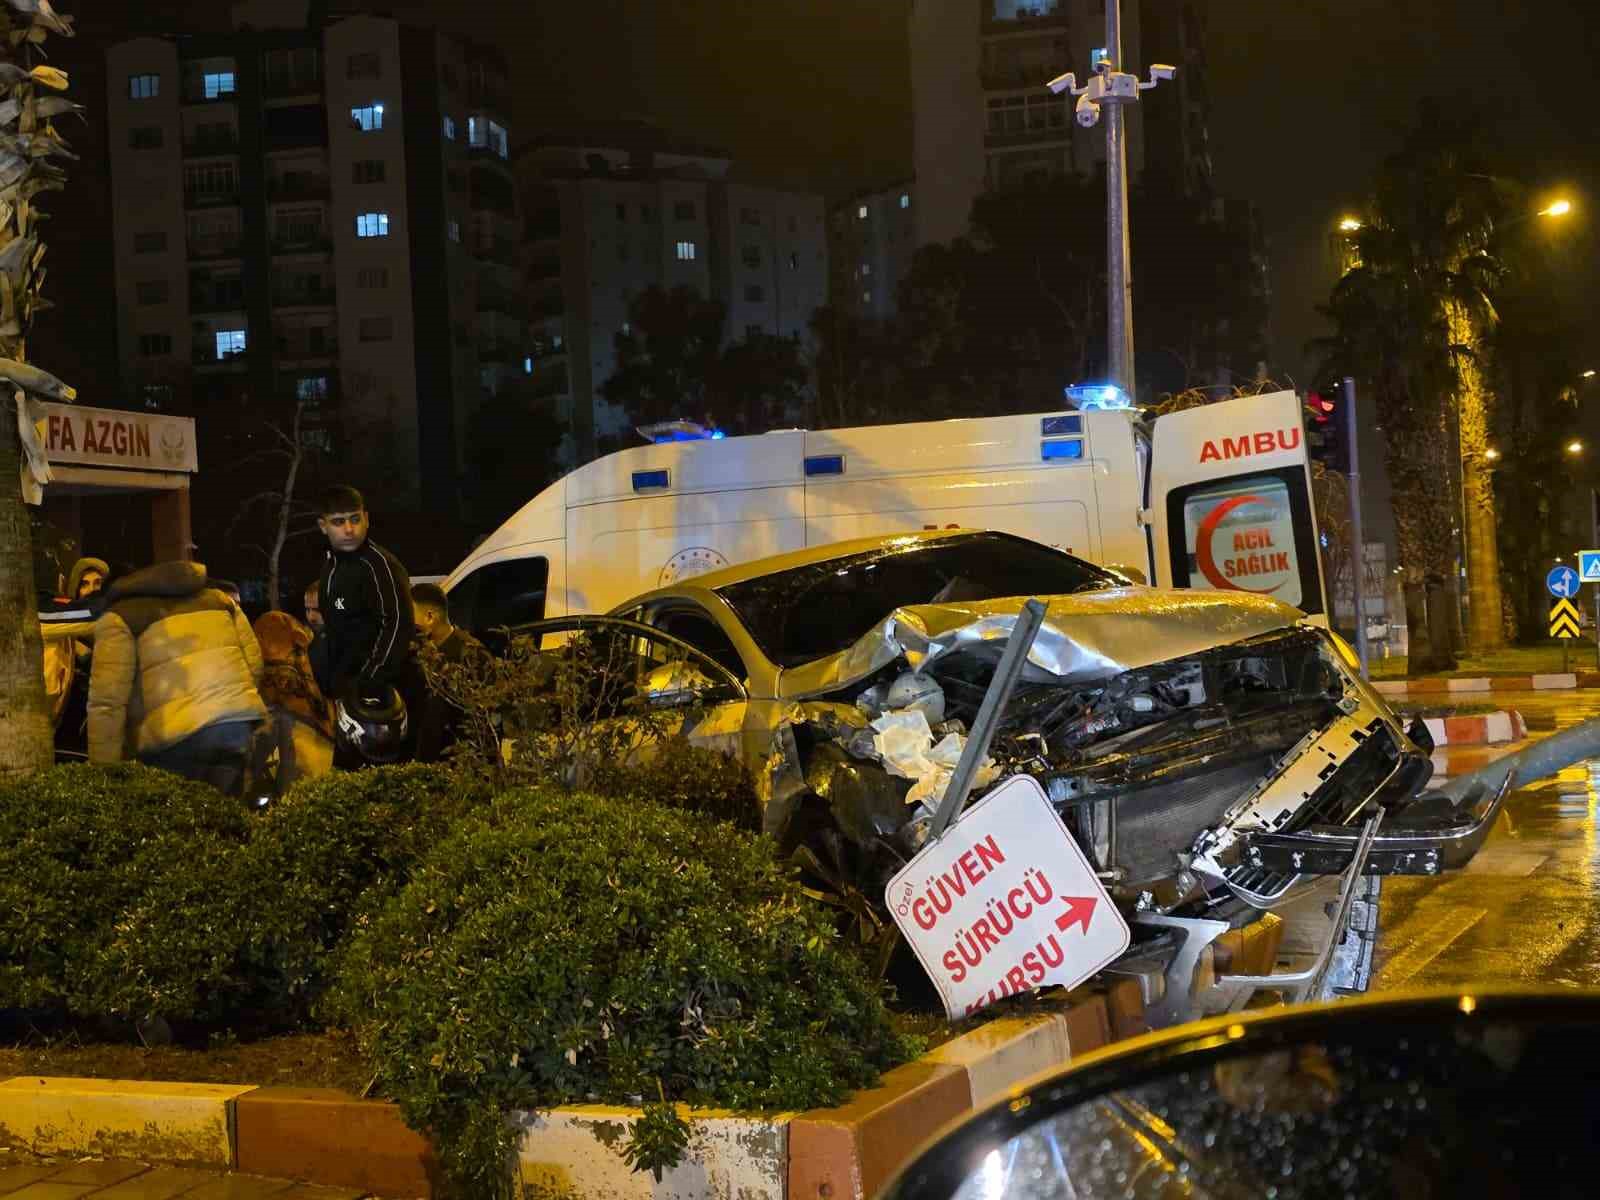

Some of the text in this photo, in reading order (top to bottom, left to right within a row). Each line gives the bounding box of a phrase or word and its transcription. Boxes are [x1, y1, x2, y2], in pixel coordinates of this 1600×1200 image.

[45, 415, 150, 457] FA AZGIN
[1200, 427, 1299, 463] AMBU
[896, 881, 914, 917] Özel
[912, 834, 1006, 930] GÜVEN
[942, 867, 1054, 983] SÜRÜCÜ
